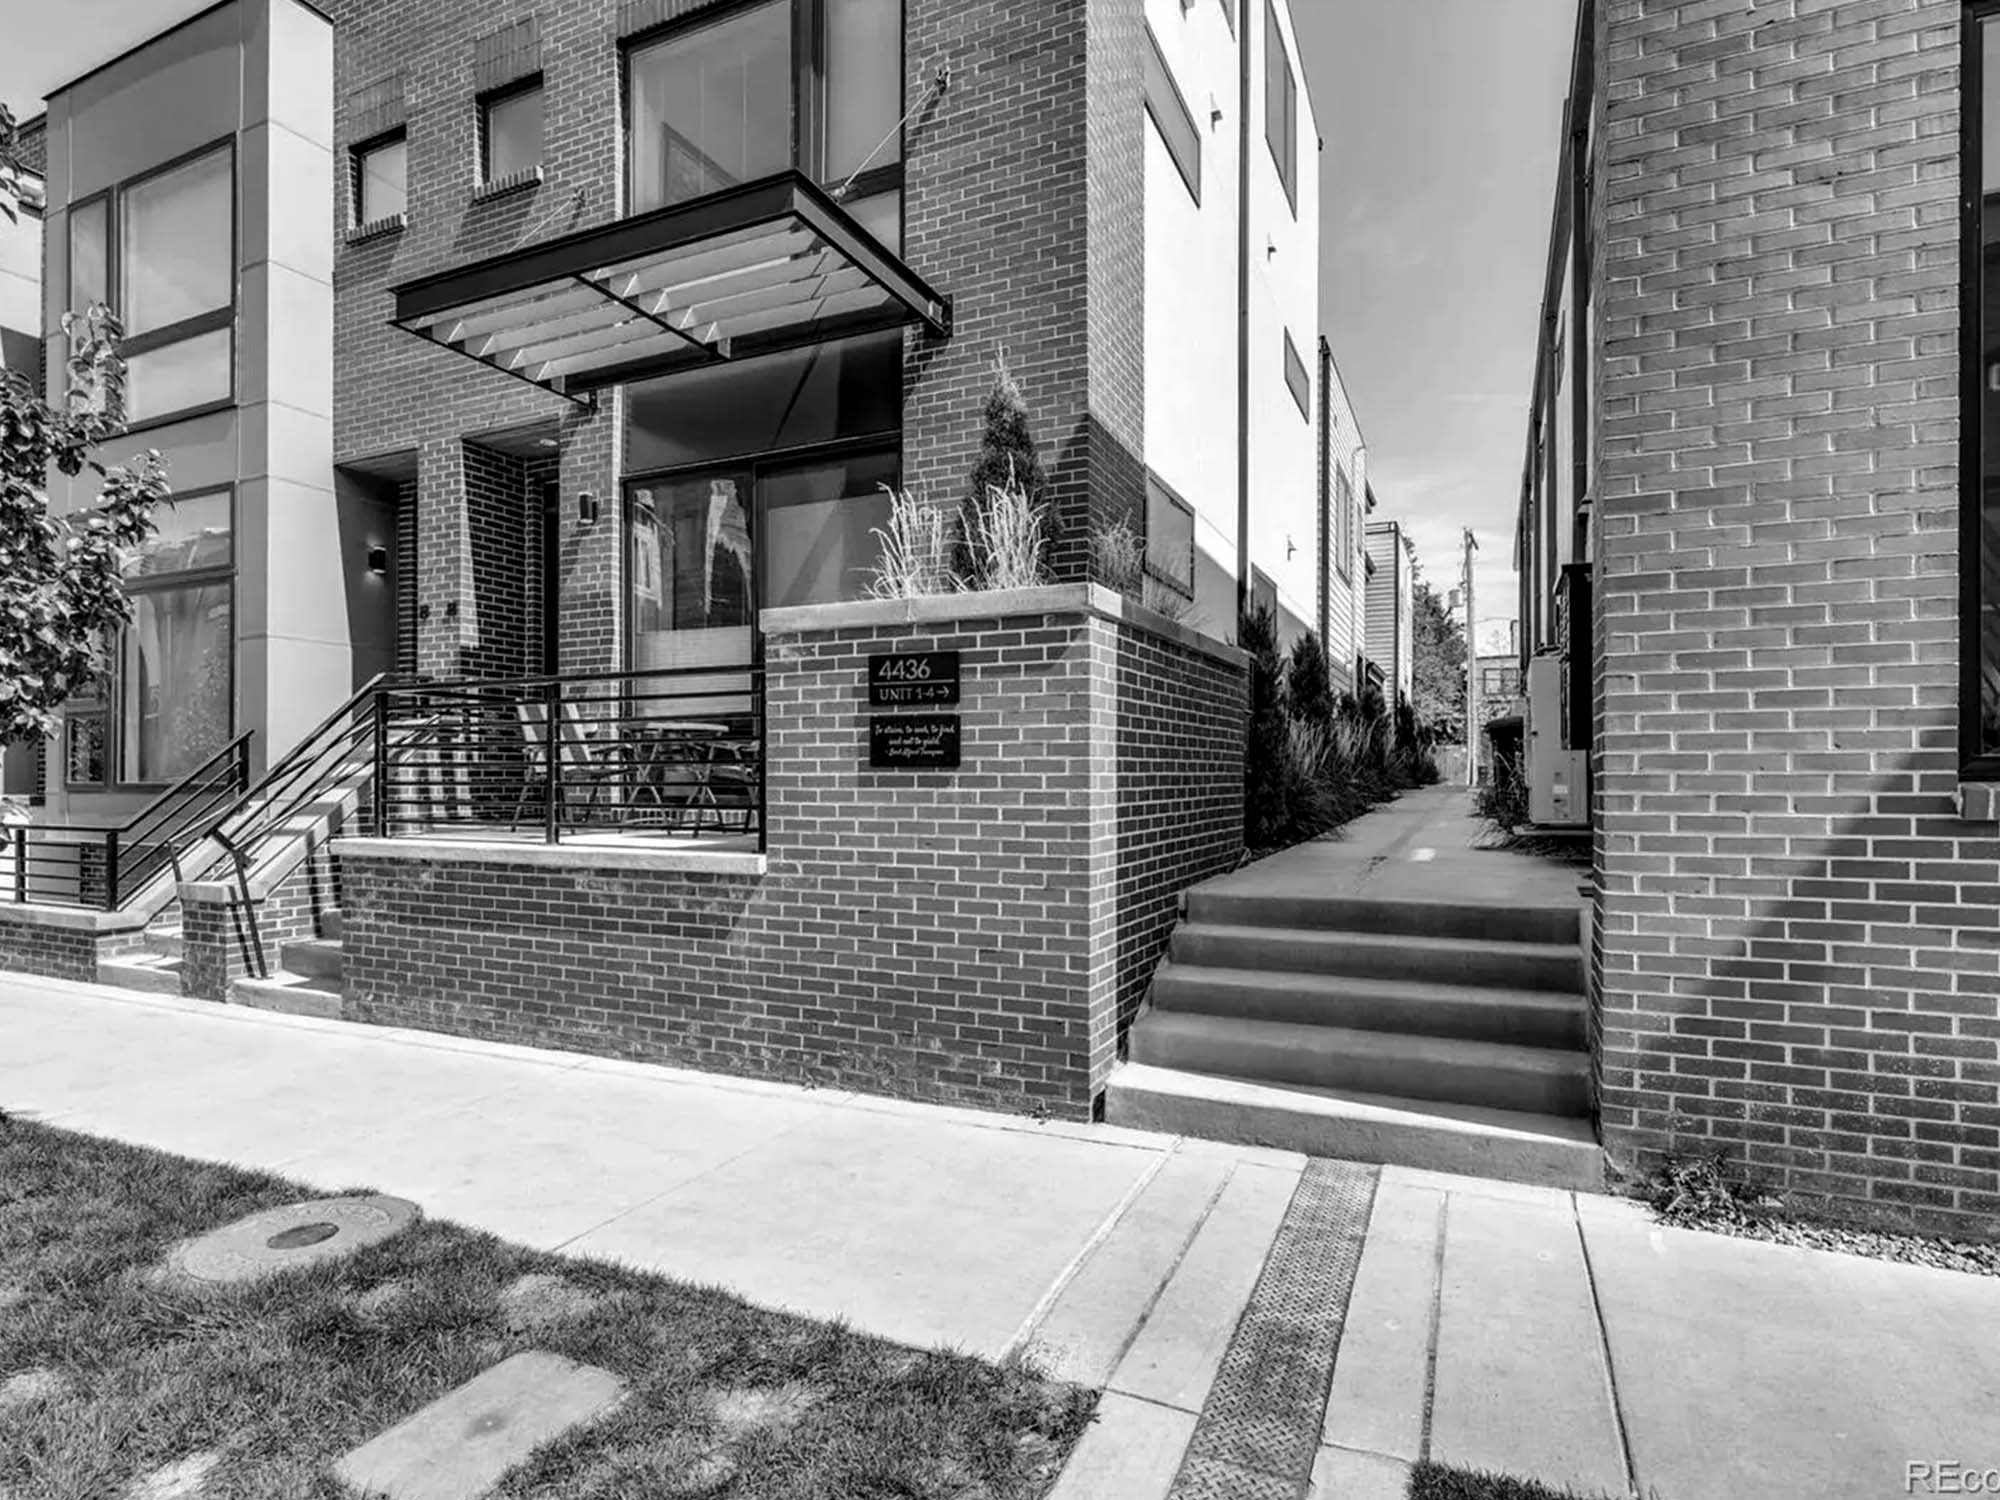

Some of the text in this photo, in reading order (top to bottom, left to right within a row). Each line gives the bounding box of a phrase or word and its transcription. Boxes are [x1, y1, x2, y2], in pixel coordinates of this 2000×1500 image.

[878, 658, 931, 680] 4436
[879, 686, 935, 701] UNIT 1-4
